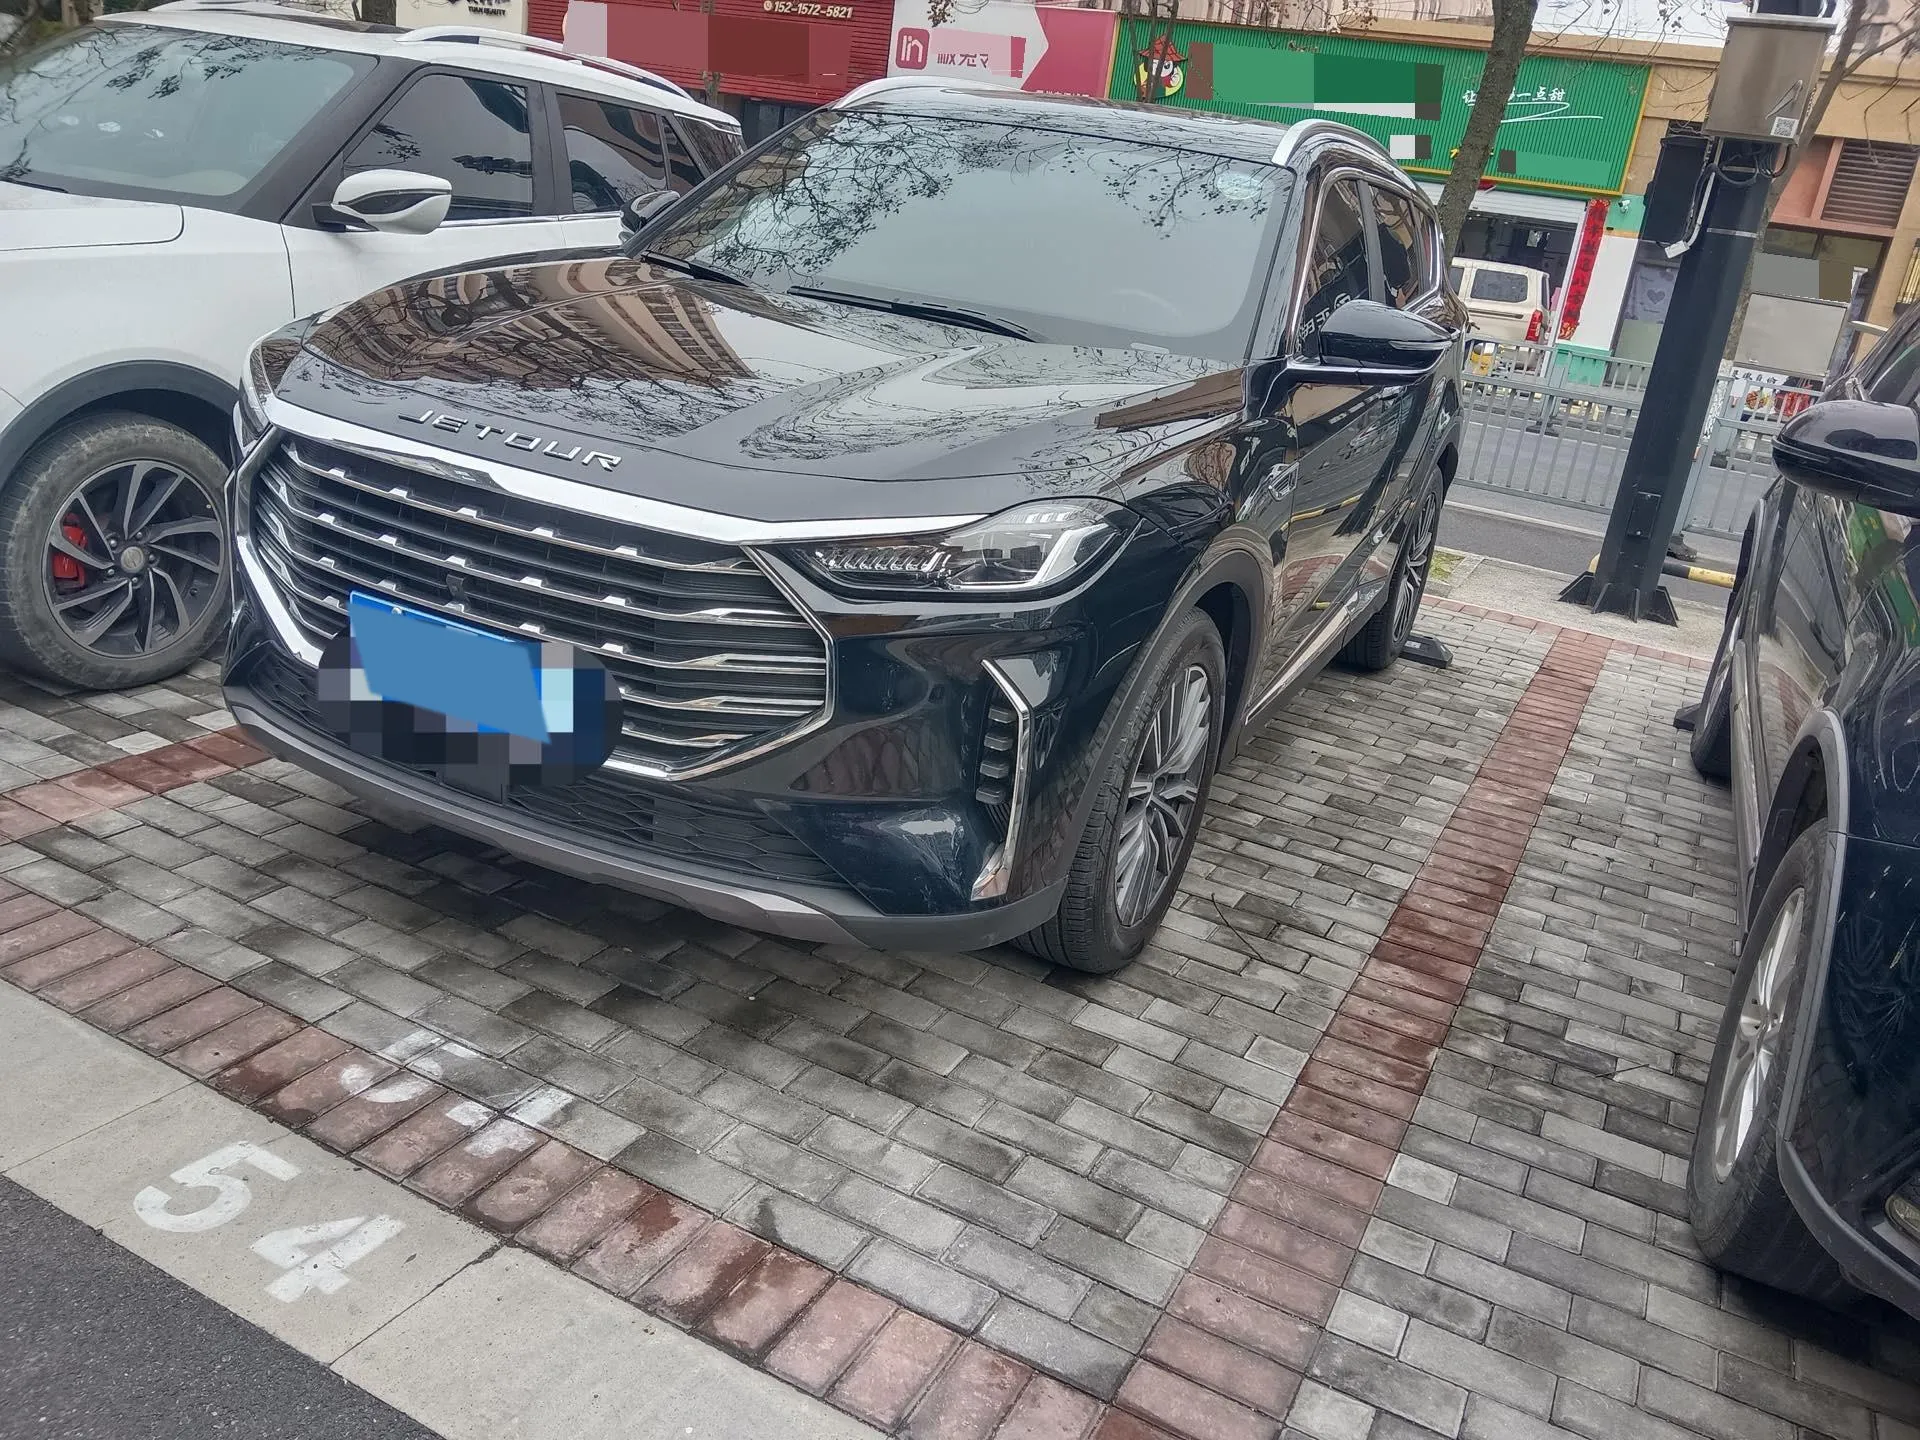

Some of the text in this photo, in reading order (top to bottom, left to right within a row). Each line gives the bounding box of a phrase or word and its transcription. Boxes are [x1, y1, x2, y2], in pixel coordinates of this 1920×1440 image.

[774, 1, 853, 19] 152-1572-5821
[398, 410, 622, 472] JETOUR
[133, 1140, 406, 1304] 54
